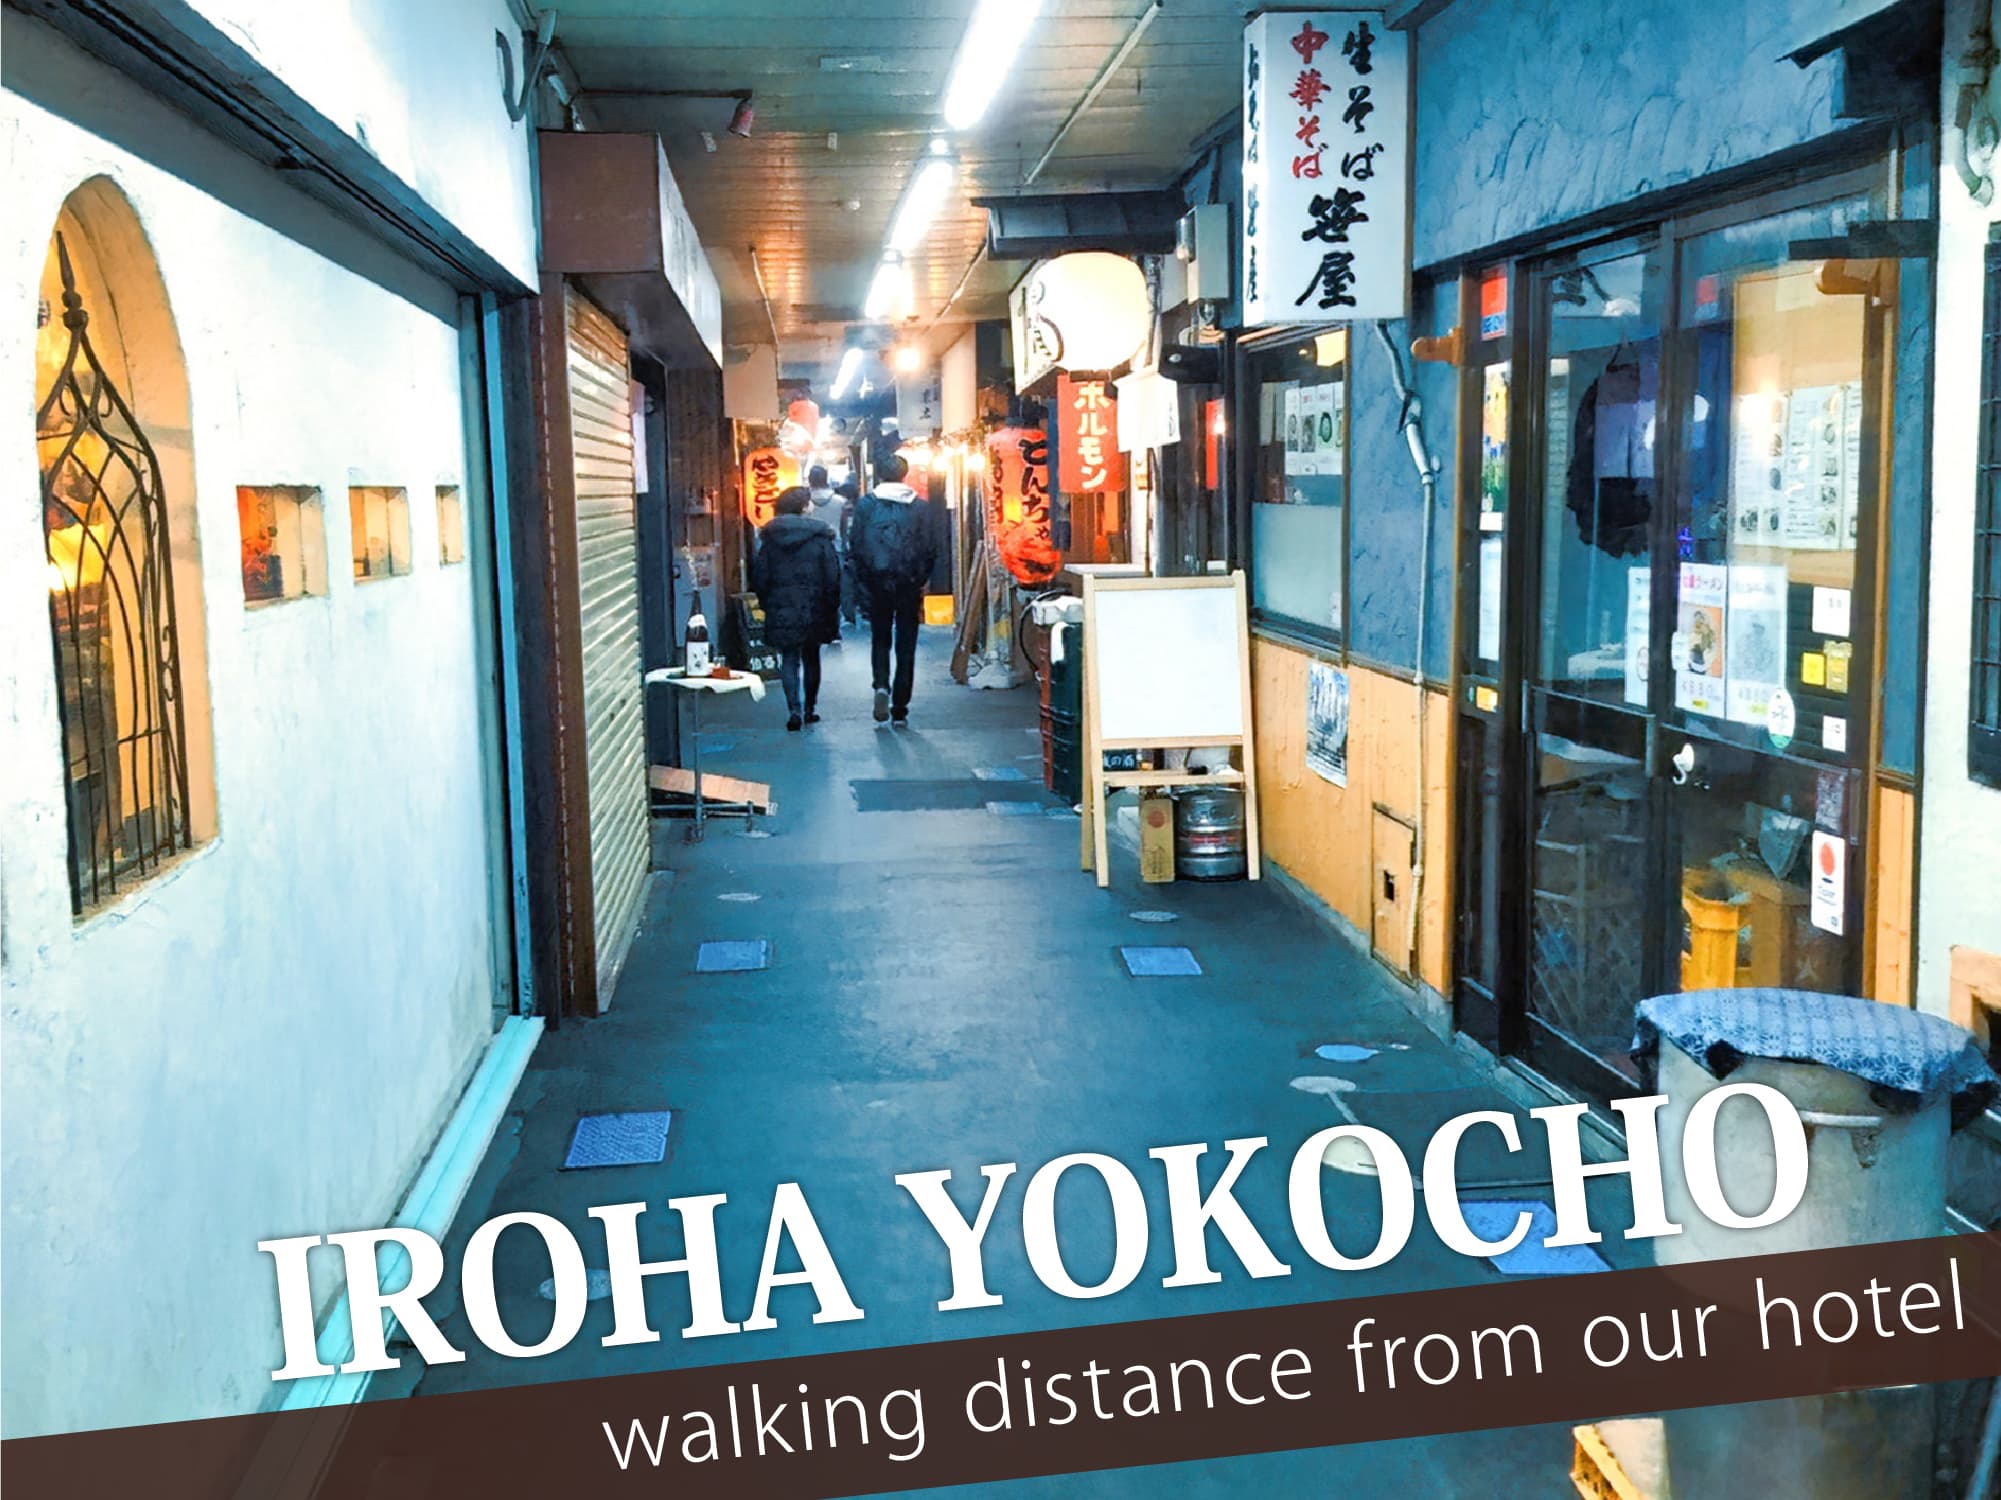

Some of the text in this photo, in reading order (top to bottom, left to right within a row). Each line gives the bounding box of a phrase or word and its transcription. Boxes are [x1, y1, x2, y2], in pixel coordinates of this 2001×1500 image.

[1289, 19, 1331, 179] 中華そば
[1341, 20, 1384, 181] 生そば
[1295, 187, 1369, 310] 笹屋
[1074, 382, 1110, 490] ホルモン
[1019, 438, 1054, 572] とんちゃ
